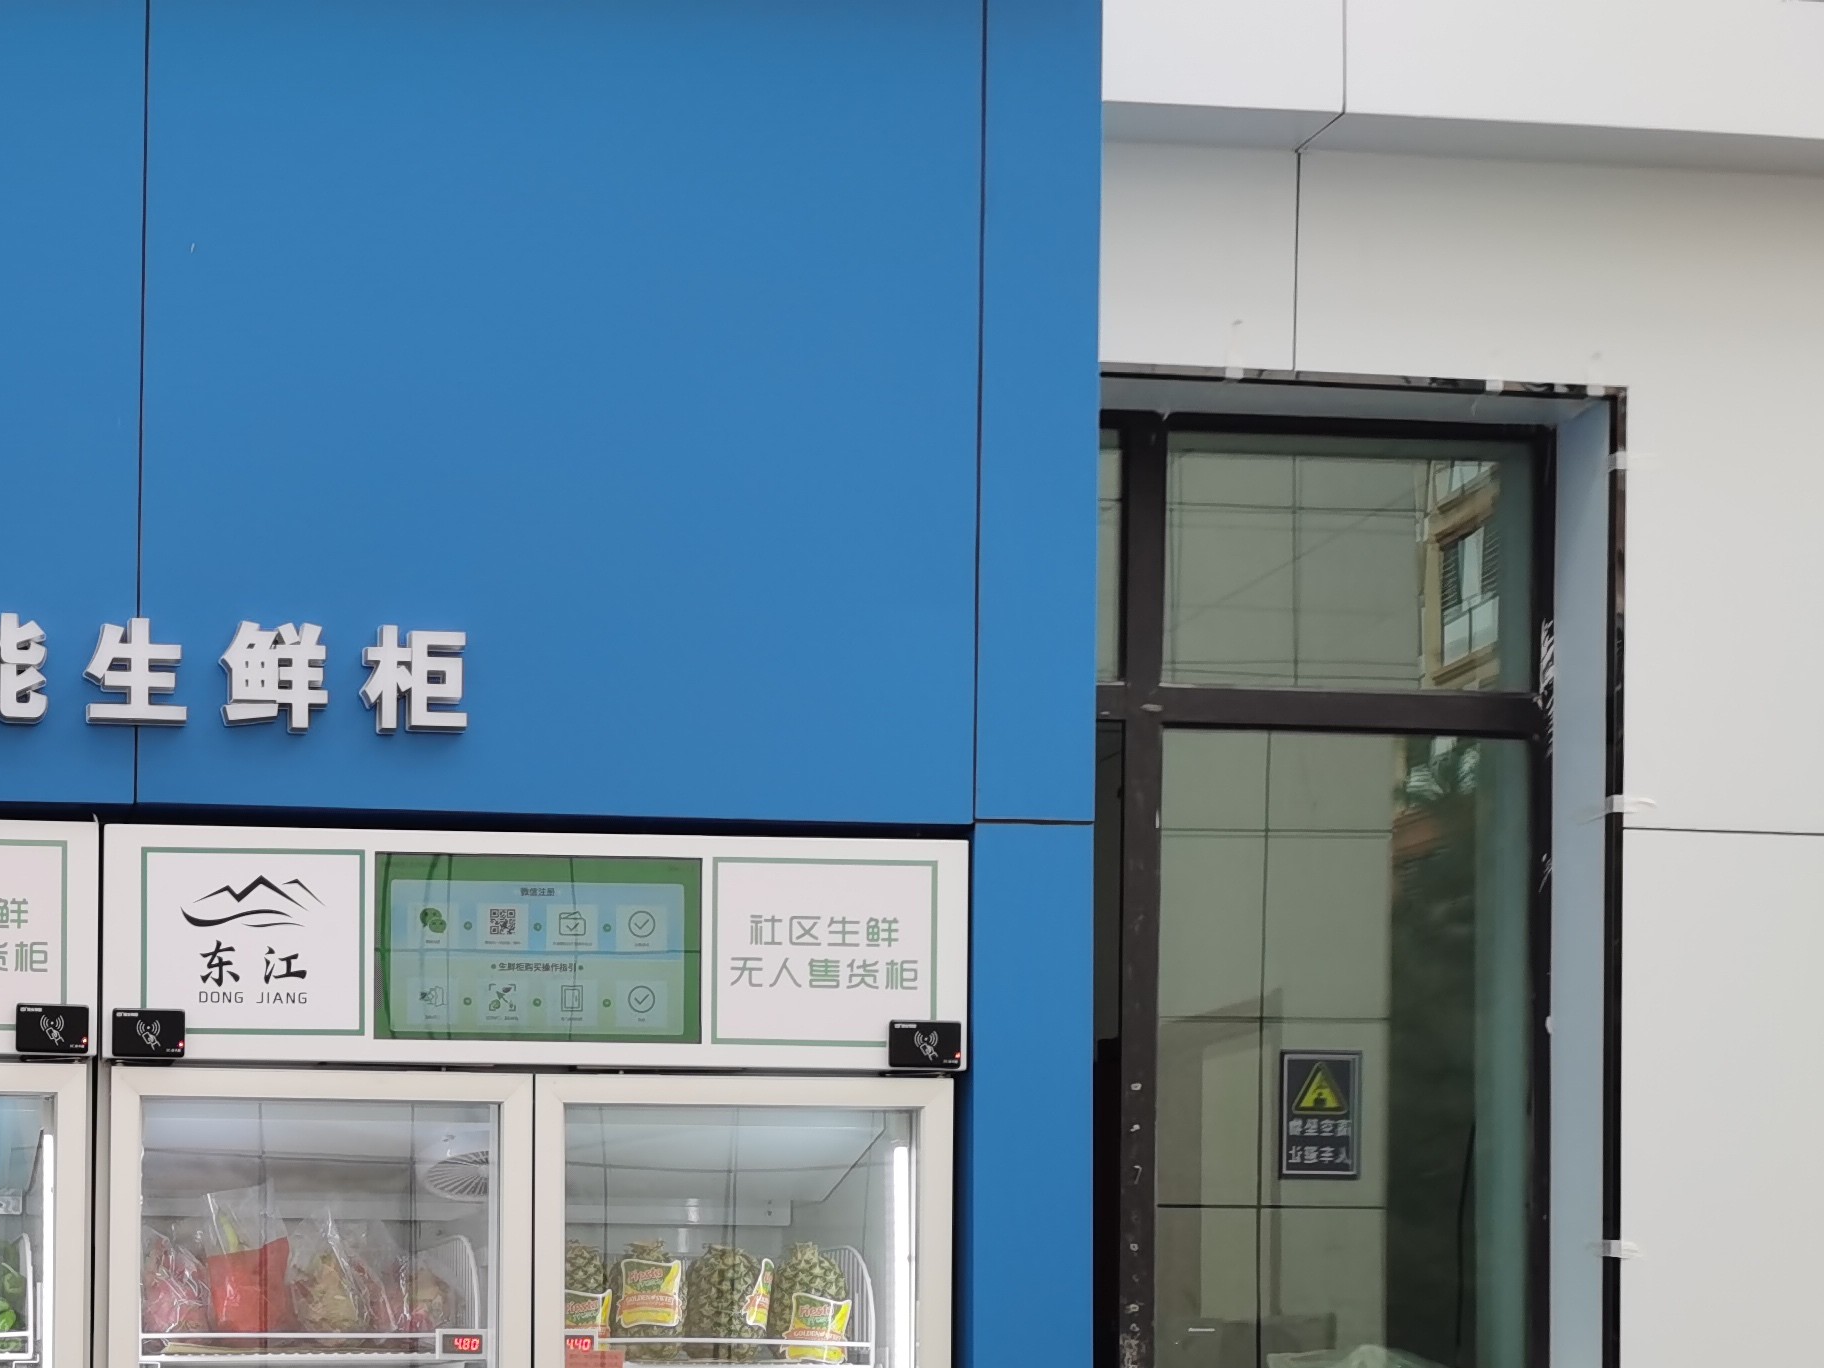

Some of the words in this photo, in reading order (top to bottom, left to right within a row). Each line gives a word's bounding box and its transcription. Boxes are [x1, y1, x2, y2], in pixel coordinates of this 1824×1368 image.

[749, 914, 900, 949] 社区生鲜
[199, 939, 308, 988] 东江
[729, 956, 919, 991] 无人售货柜
[198, 990, 244, 1004] DONG
[256, 991, 308, 1005] JIANG
